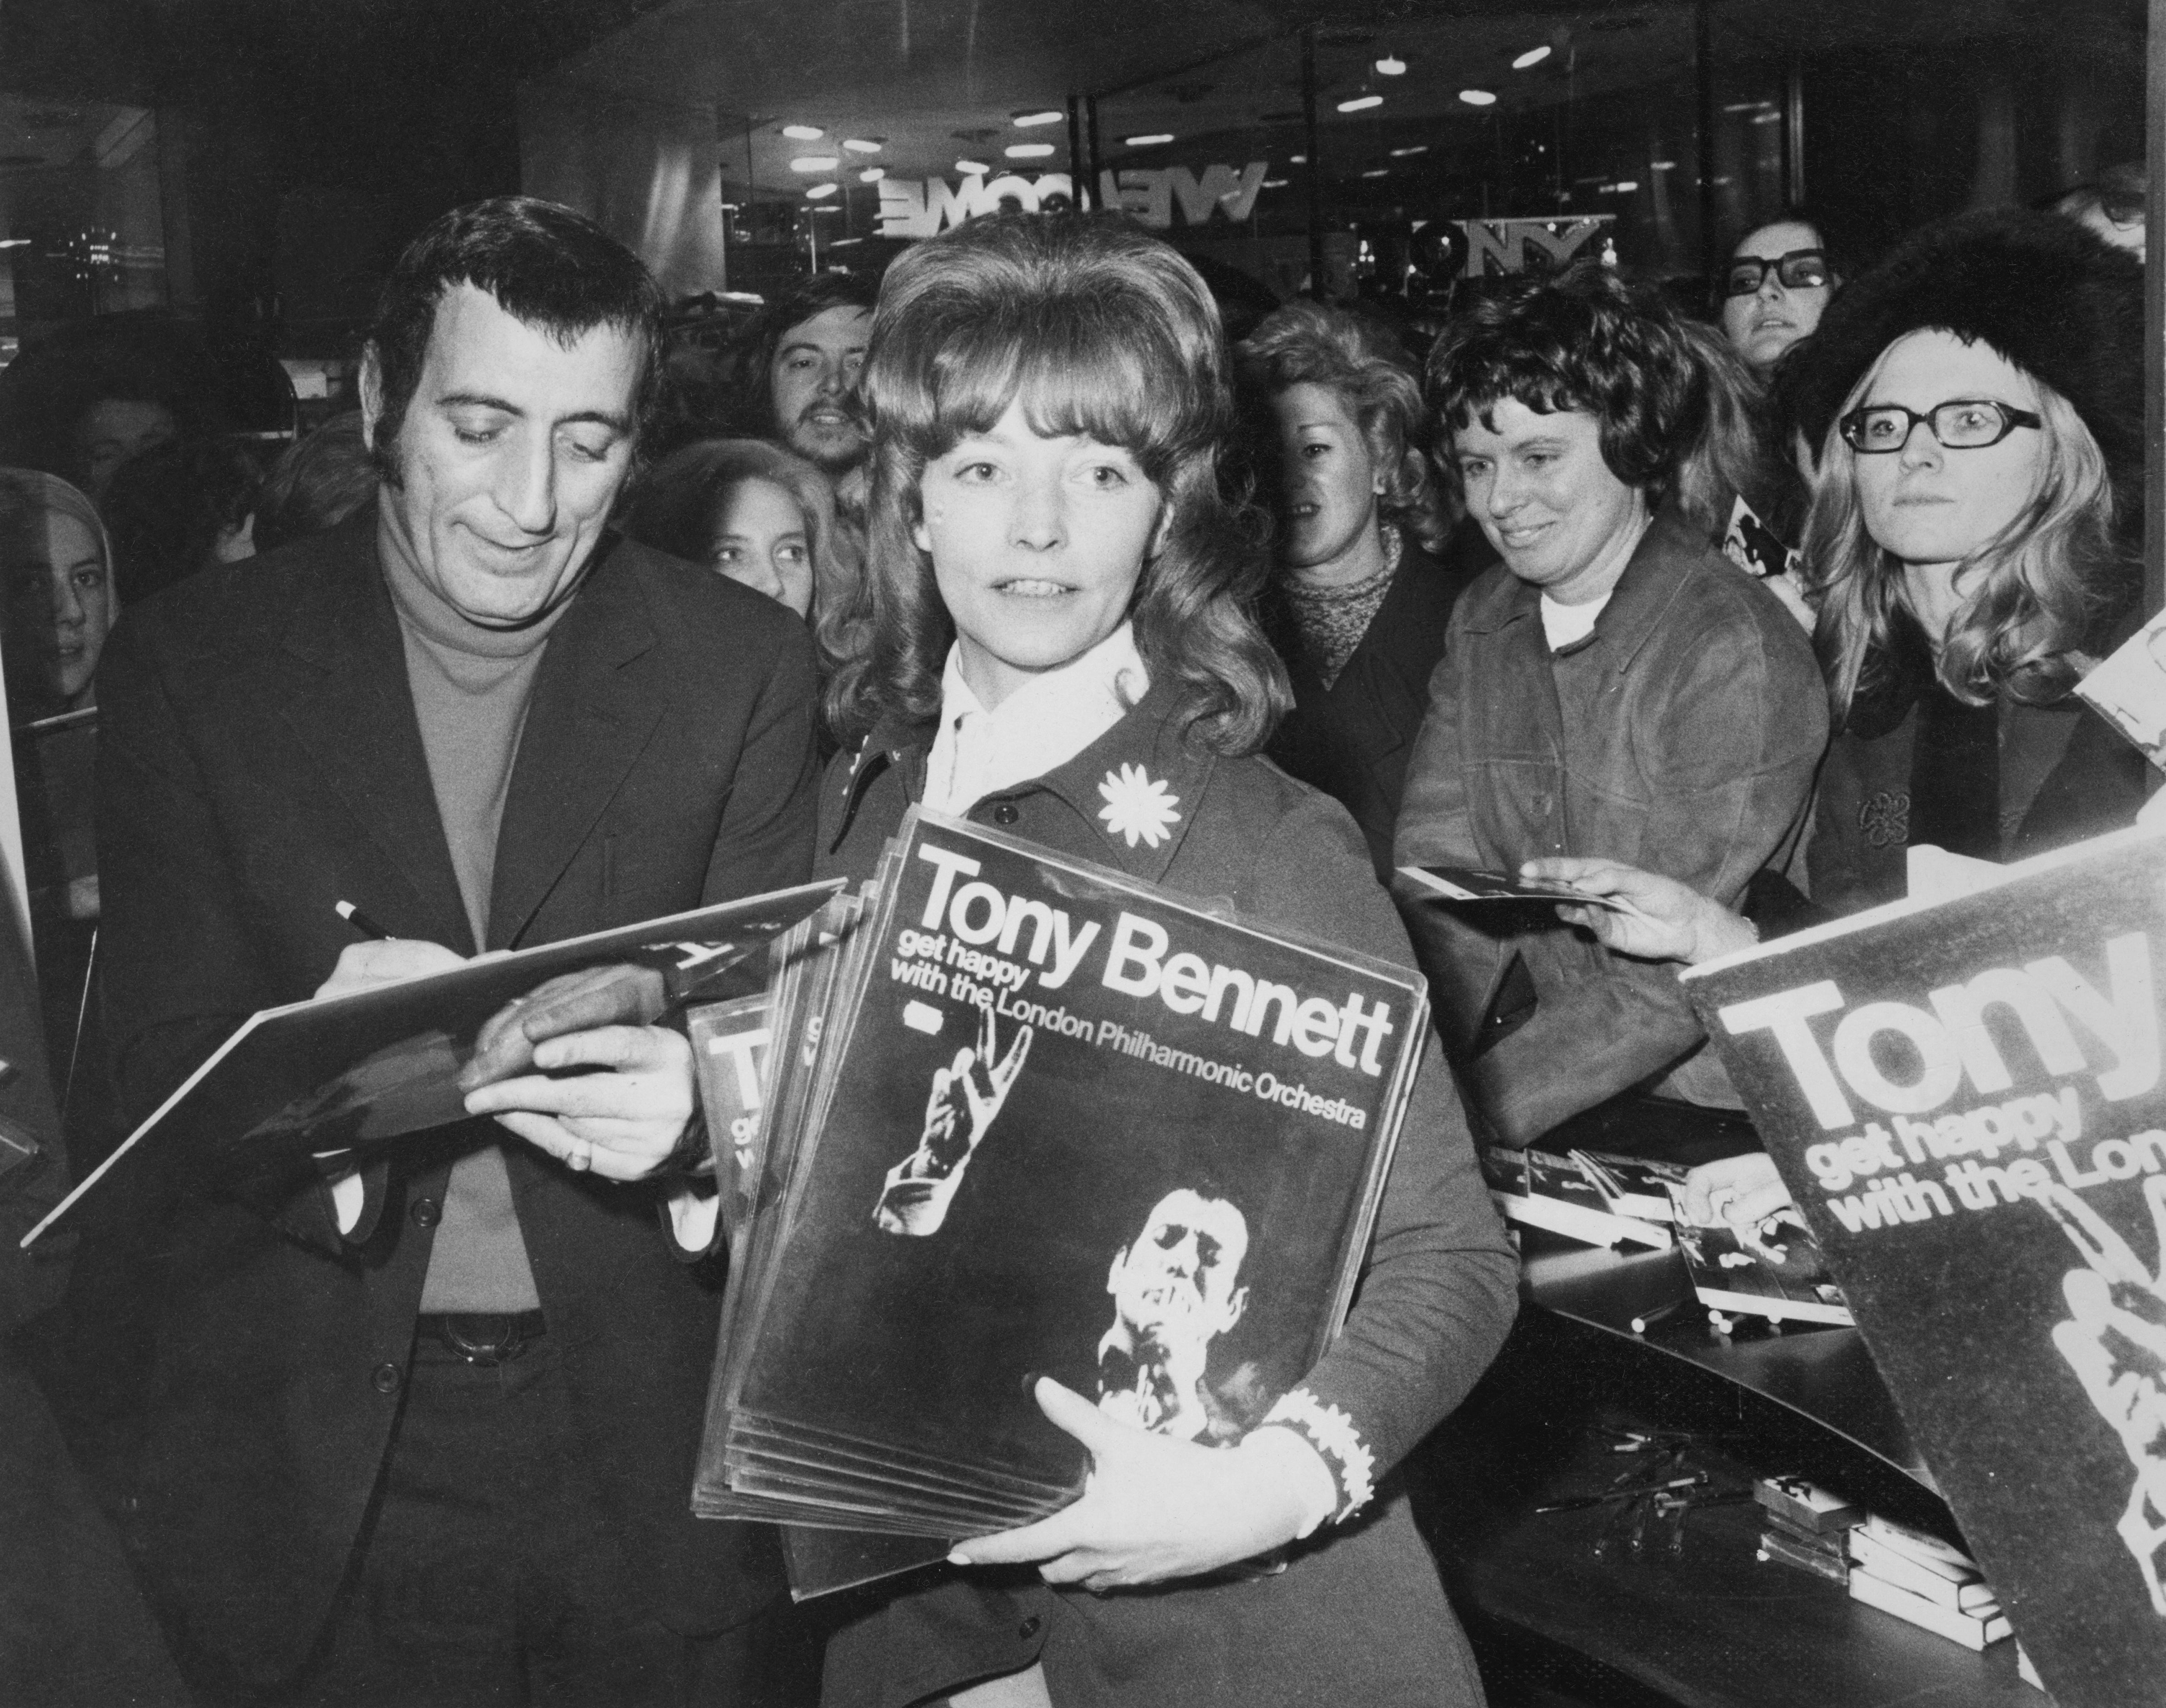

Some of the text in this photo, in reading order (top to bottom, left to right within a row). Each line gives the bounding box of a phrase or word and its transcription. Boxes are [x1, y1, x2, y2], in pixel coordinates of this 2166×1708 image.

[898, 929, 1030, 992] get happy
[918, 842, 1393, 1076] Tony Bennett
[891, 958, 1366, 1130] with the London Philharmonic Orchestra
[1718, 931, 2162, 1130] Tony
[1805, 1086, 2082, 1190] get happy
[1826, 1173, 1954, 1232] with
[1944, 1158, 2051, 1210] the
